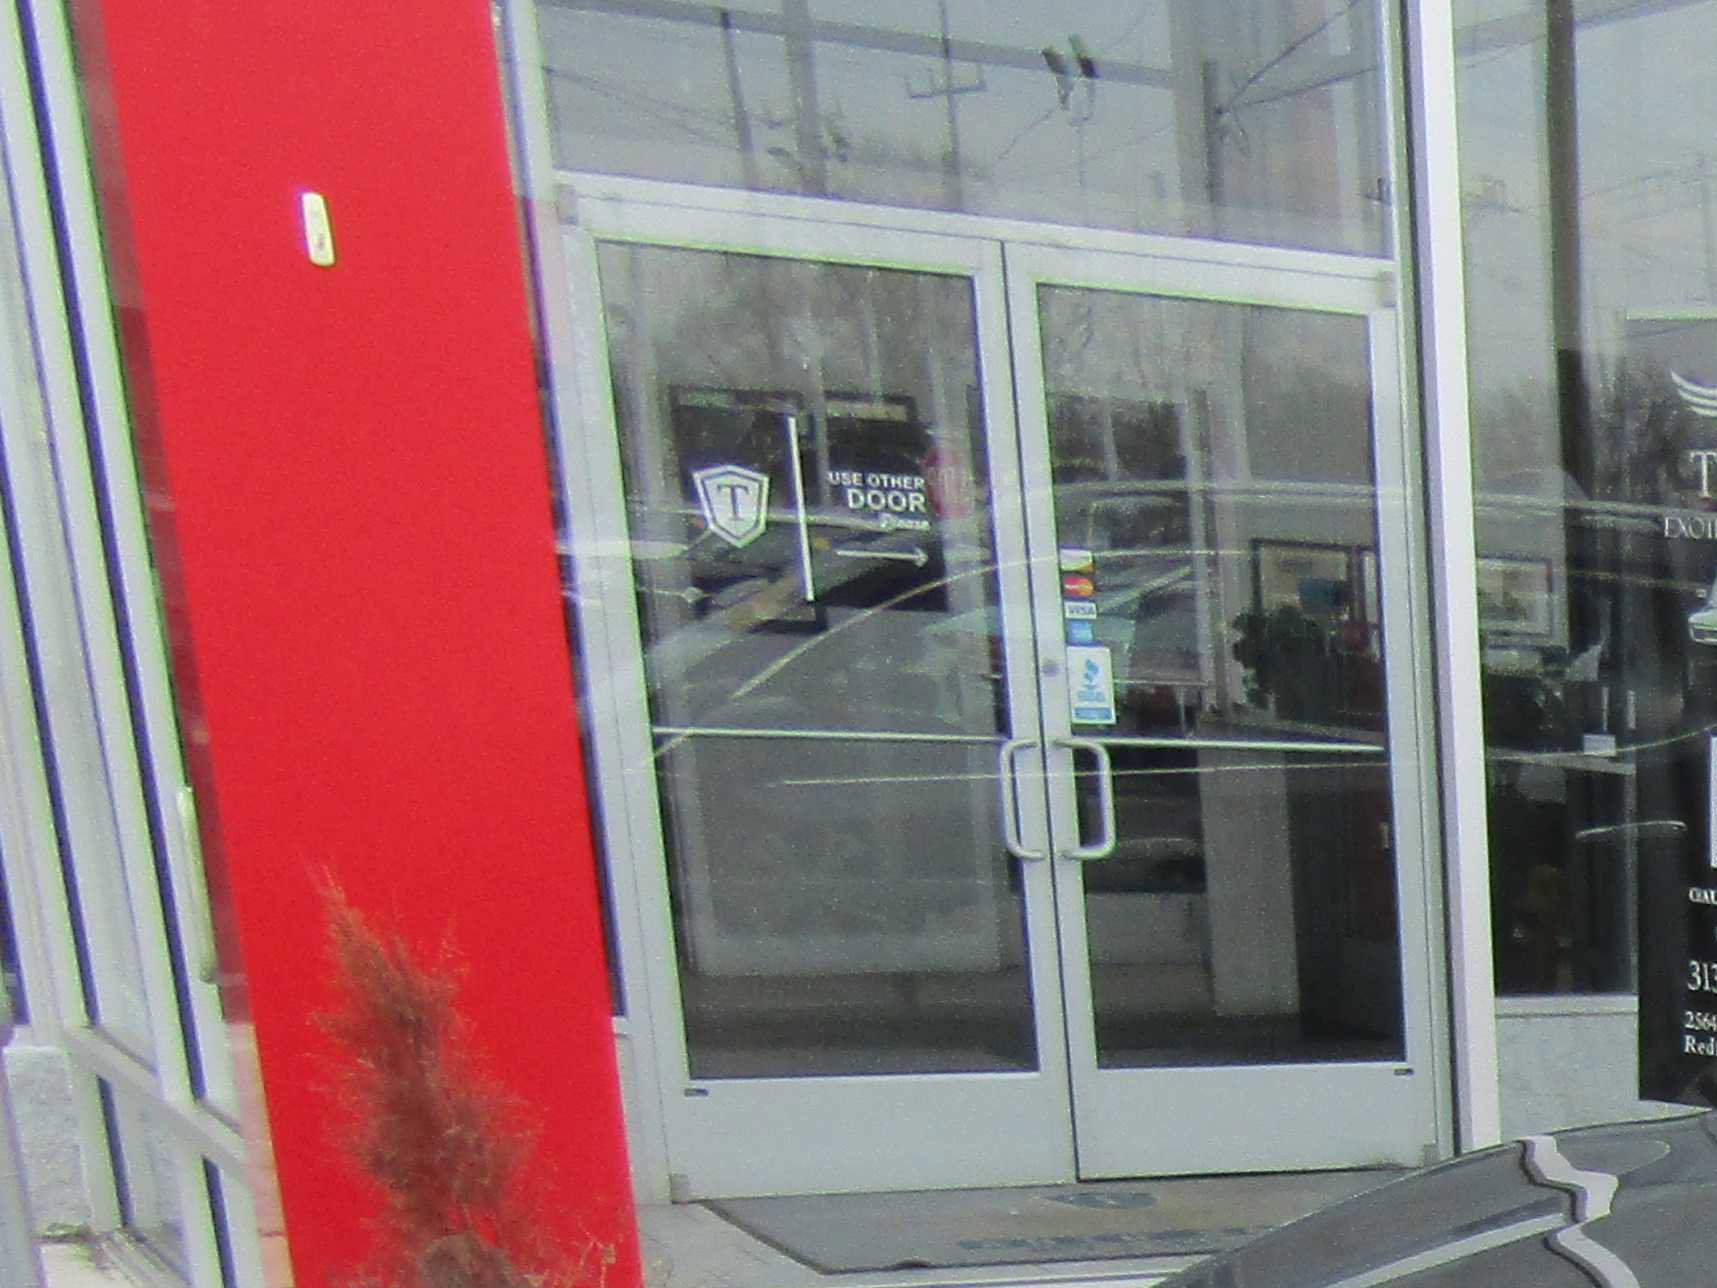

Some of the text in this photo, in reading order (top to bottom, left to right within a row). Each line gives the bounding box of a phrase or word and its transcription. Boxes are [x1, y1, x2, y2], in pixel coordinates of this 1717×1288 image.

[828, 472, 861, 485] USE
[868, 472, 925, 490] OTHER
[847, 488, 928, 513] DOOR
